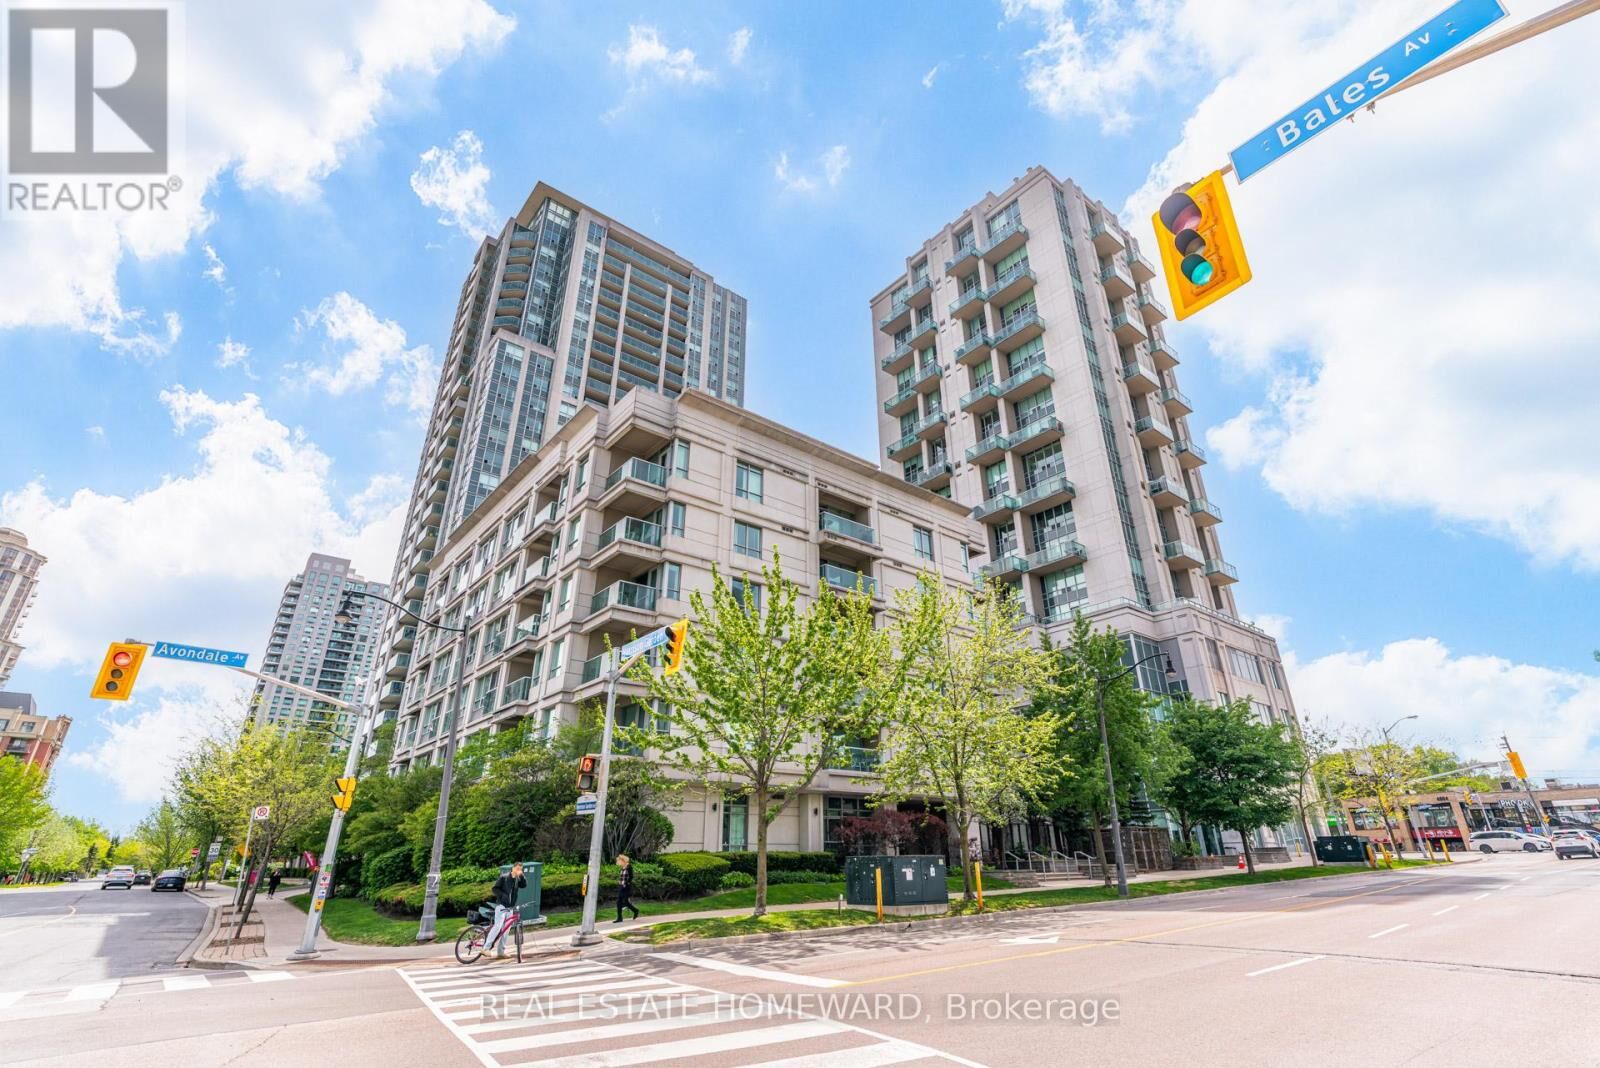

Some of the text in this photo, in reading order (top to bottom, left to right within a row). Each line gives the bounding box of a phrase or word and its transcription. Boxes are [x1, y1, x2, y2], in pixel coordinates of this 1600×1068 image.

[1275, 31, 1431, 148] Bales Av
[157, 643, 229, 663] Avondale
